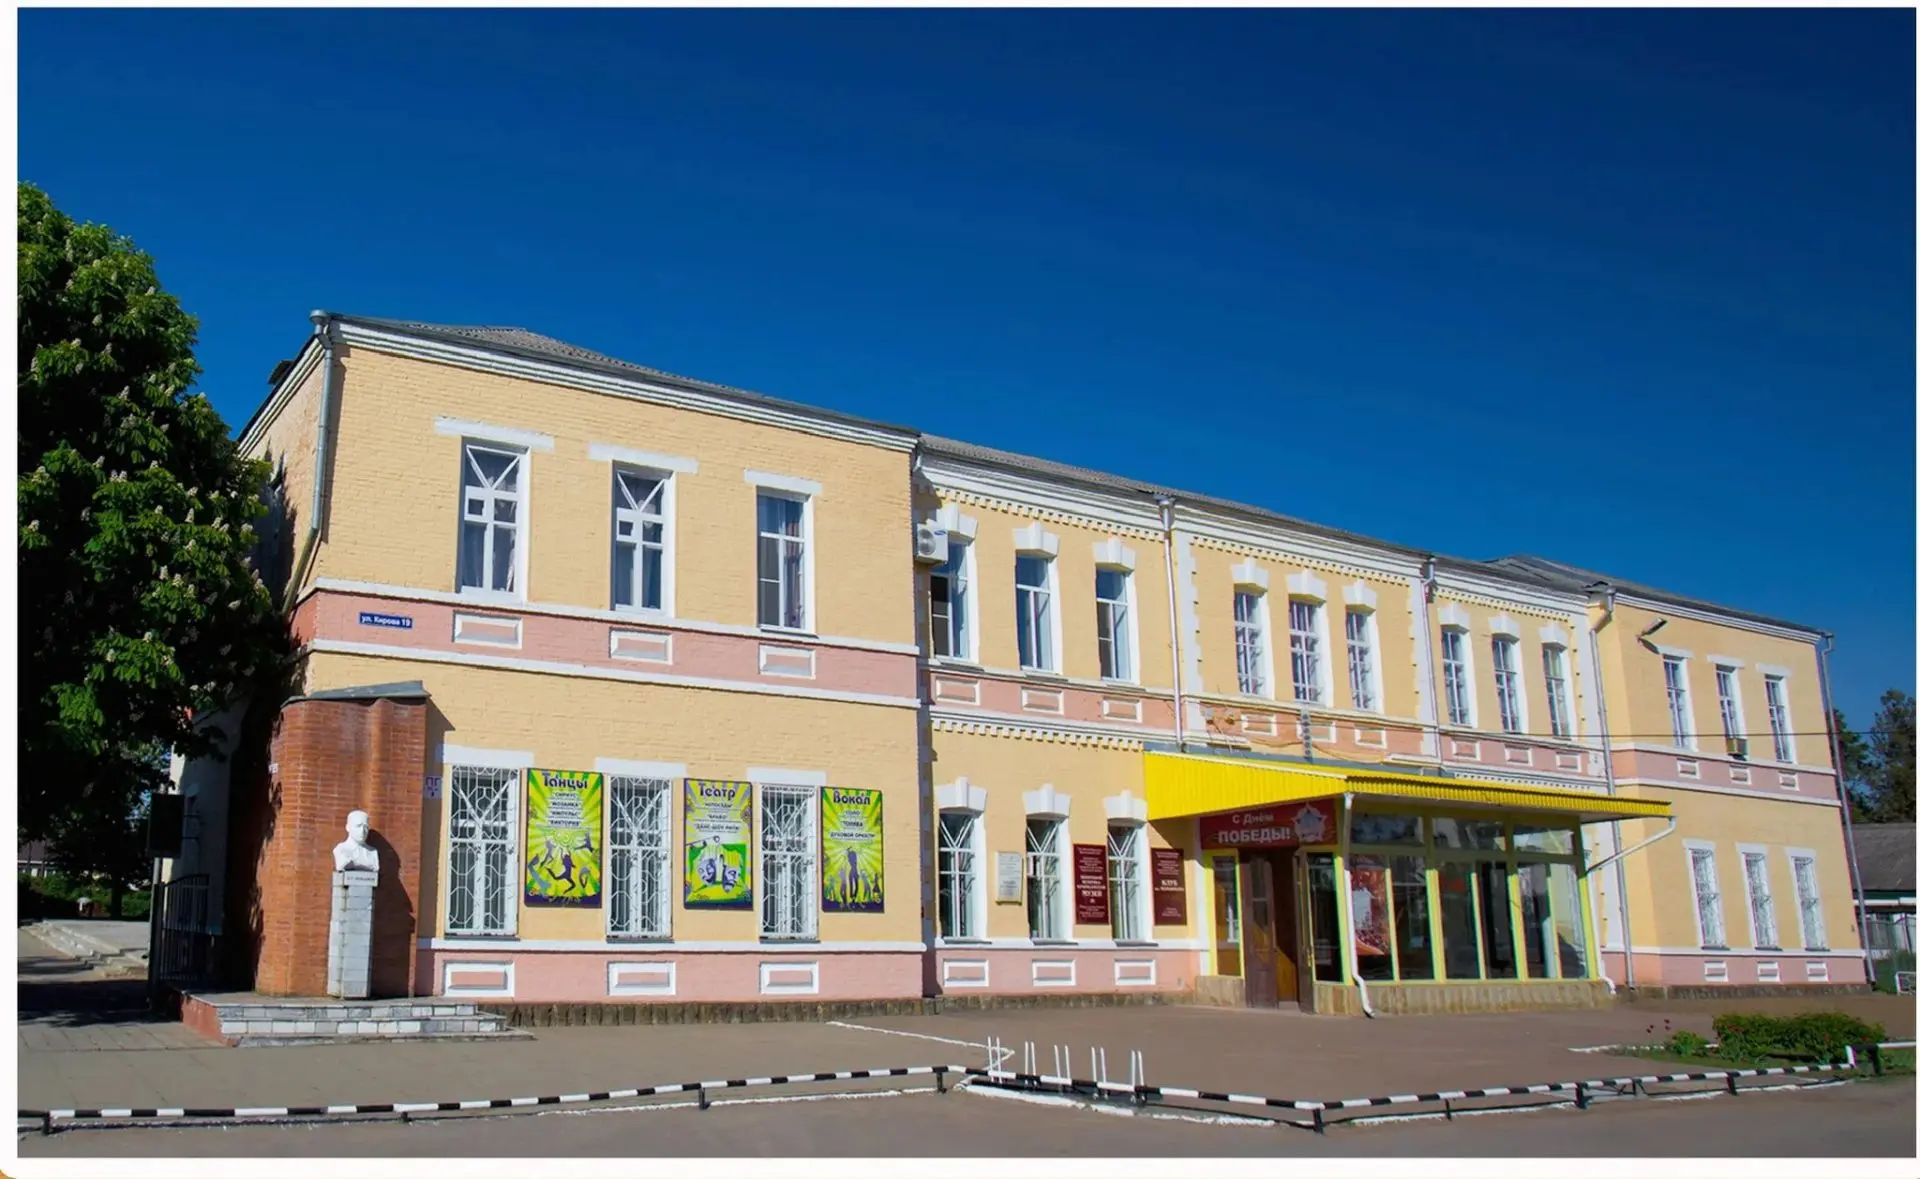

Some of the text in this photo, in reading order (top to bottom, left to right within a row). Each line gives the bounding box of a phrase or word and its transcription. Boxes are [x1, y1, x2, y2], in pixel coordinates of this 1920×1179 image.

[361, 615, 411, 627] ул. Кирова 19
[1232, 813, 1240, 824] С
[1218, 827, 1291, 843] ПОБЕДЫ!
